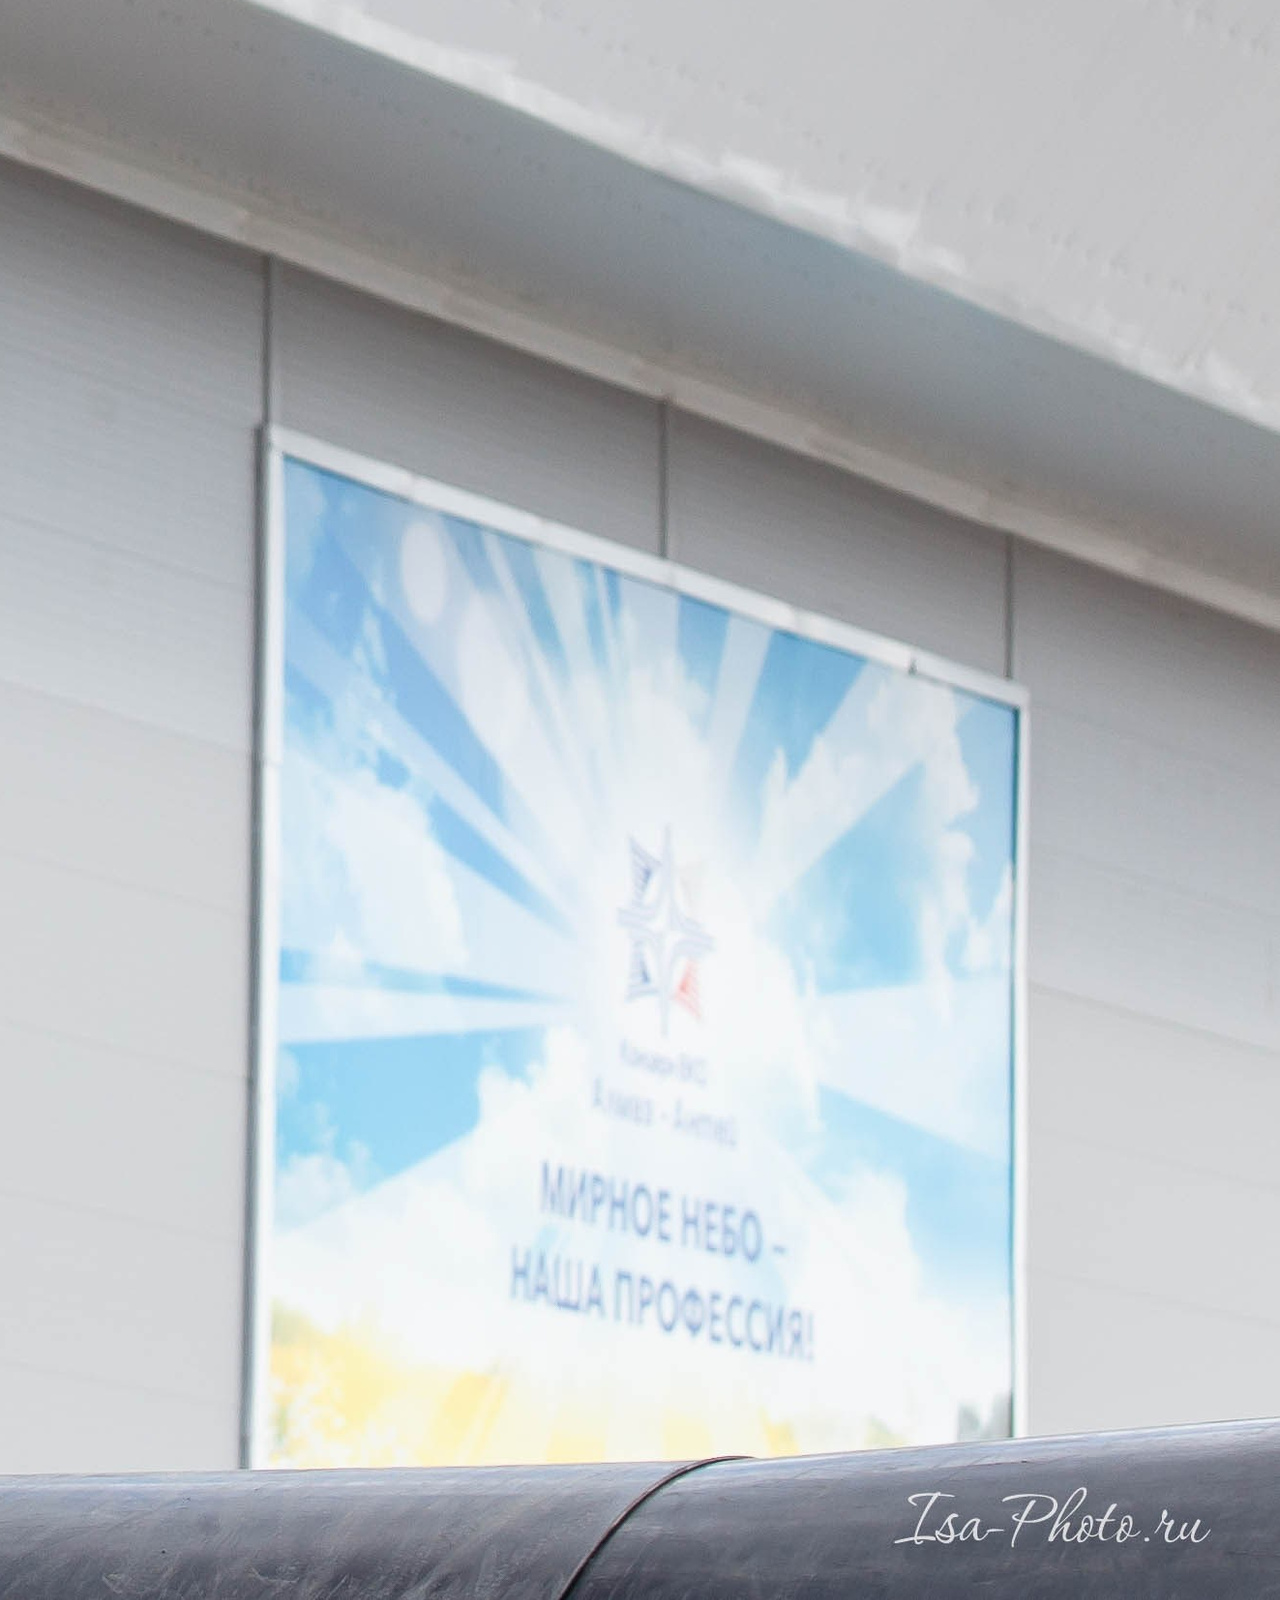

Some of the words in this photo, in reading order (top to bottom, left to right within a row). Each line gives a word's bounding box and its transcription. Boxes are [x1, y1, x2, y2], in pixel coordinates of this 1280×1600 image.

[540, 1160, 672, 1242] МИРНОЕ
[681, 1195, 764, 1264] НЕБО
[510, 1244, 607, 1321] НАША
[613, 1268, 816, 1363] ПРОФЕССИЯ!
